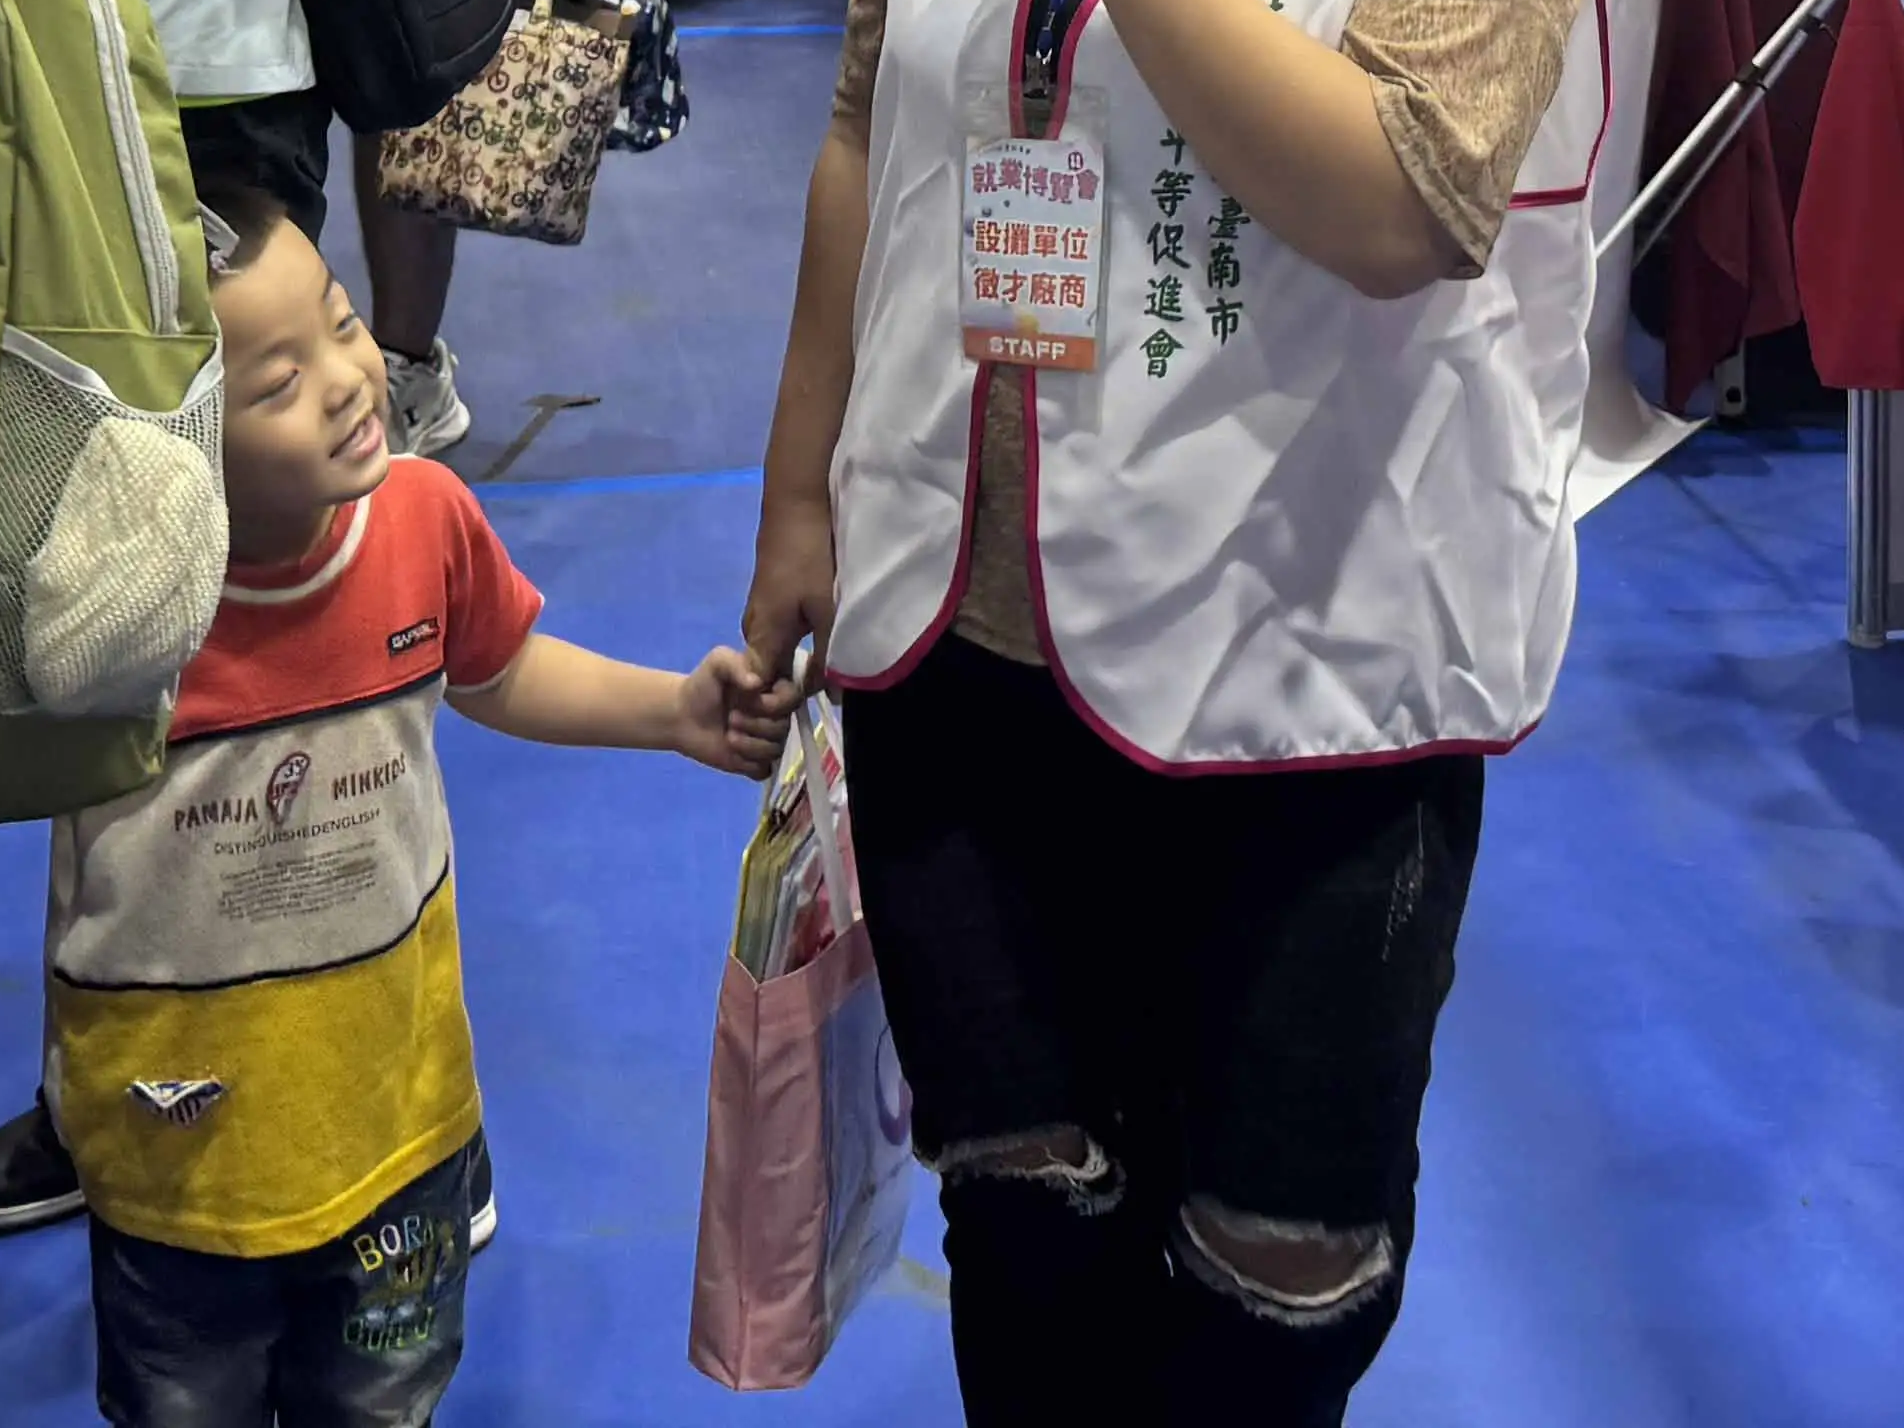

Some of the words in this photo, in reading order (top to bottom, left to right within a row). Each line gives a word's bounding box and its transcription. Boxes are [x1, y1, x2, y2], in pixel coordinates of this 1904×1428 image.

[975, 219, 1089, 260] 設攤單位
[973, 266, 1088, 309] 徵才廠商
[1205, 195, 1252, 347] 臺南市
[988, 335, 1068, 361] STAFF
